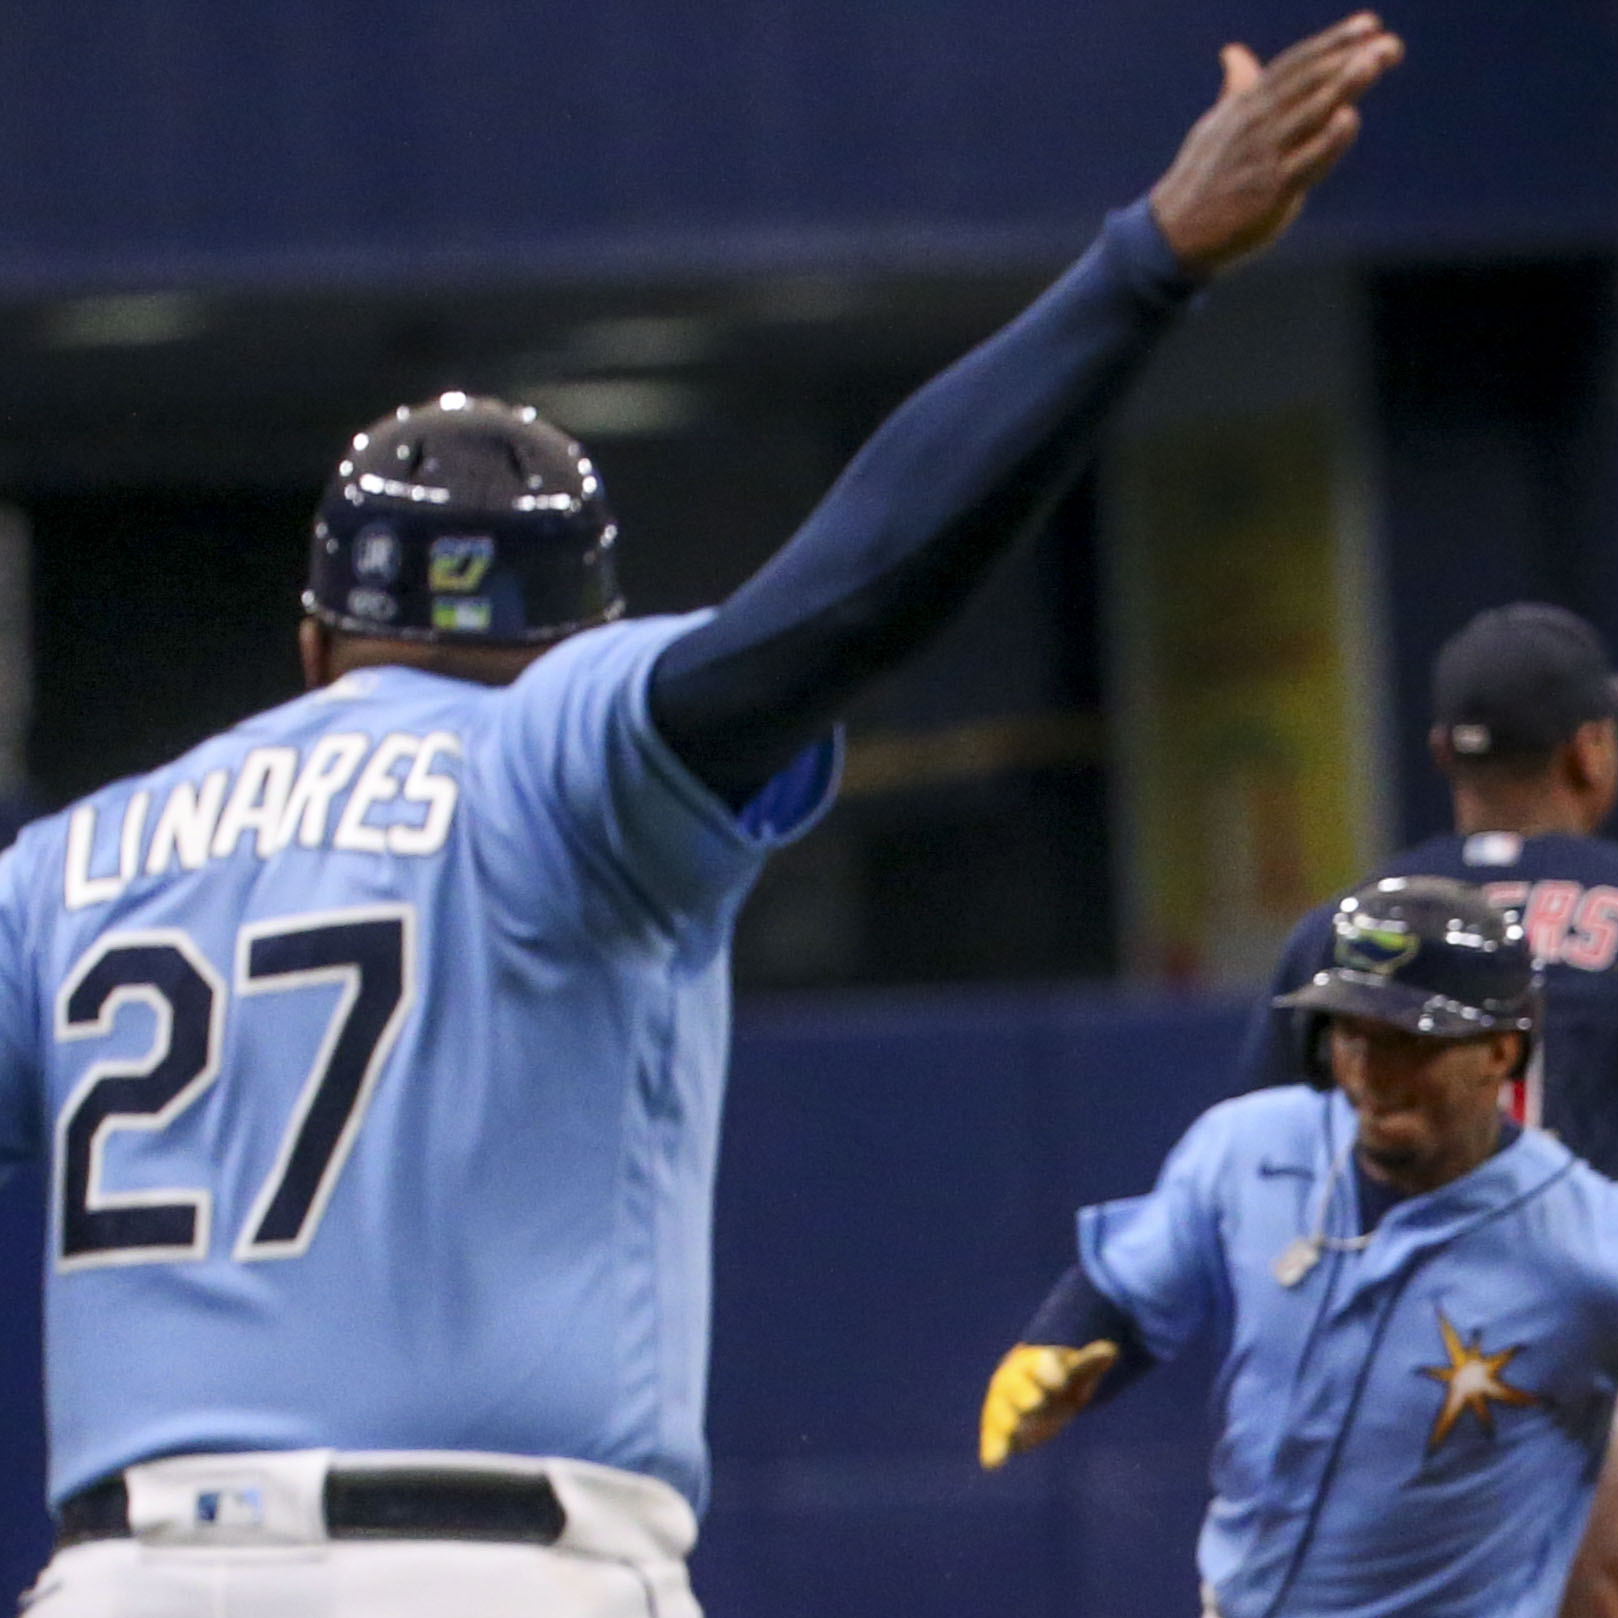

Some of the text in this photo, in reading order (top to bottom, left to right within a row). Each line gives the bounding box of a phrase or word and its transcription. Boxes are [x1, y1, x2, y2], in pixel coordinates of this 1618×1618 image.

[429, 536, 495, 592] 27
[64, 731, 460, 909] LINARES
[54, 903, 416, 1273] 27
